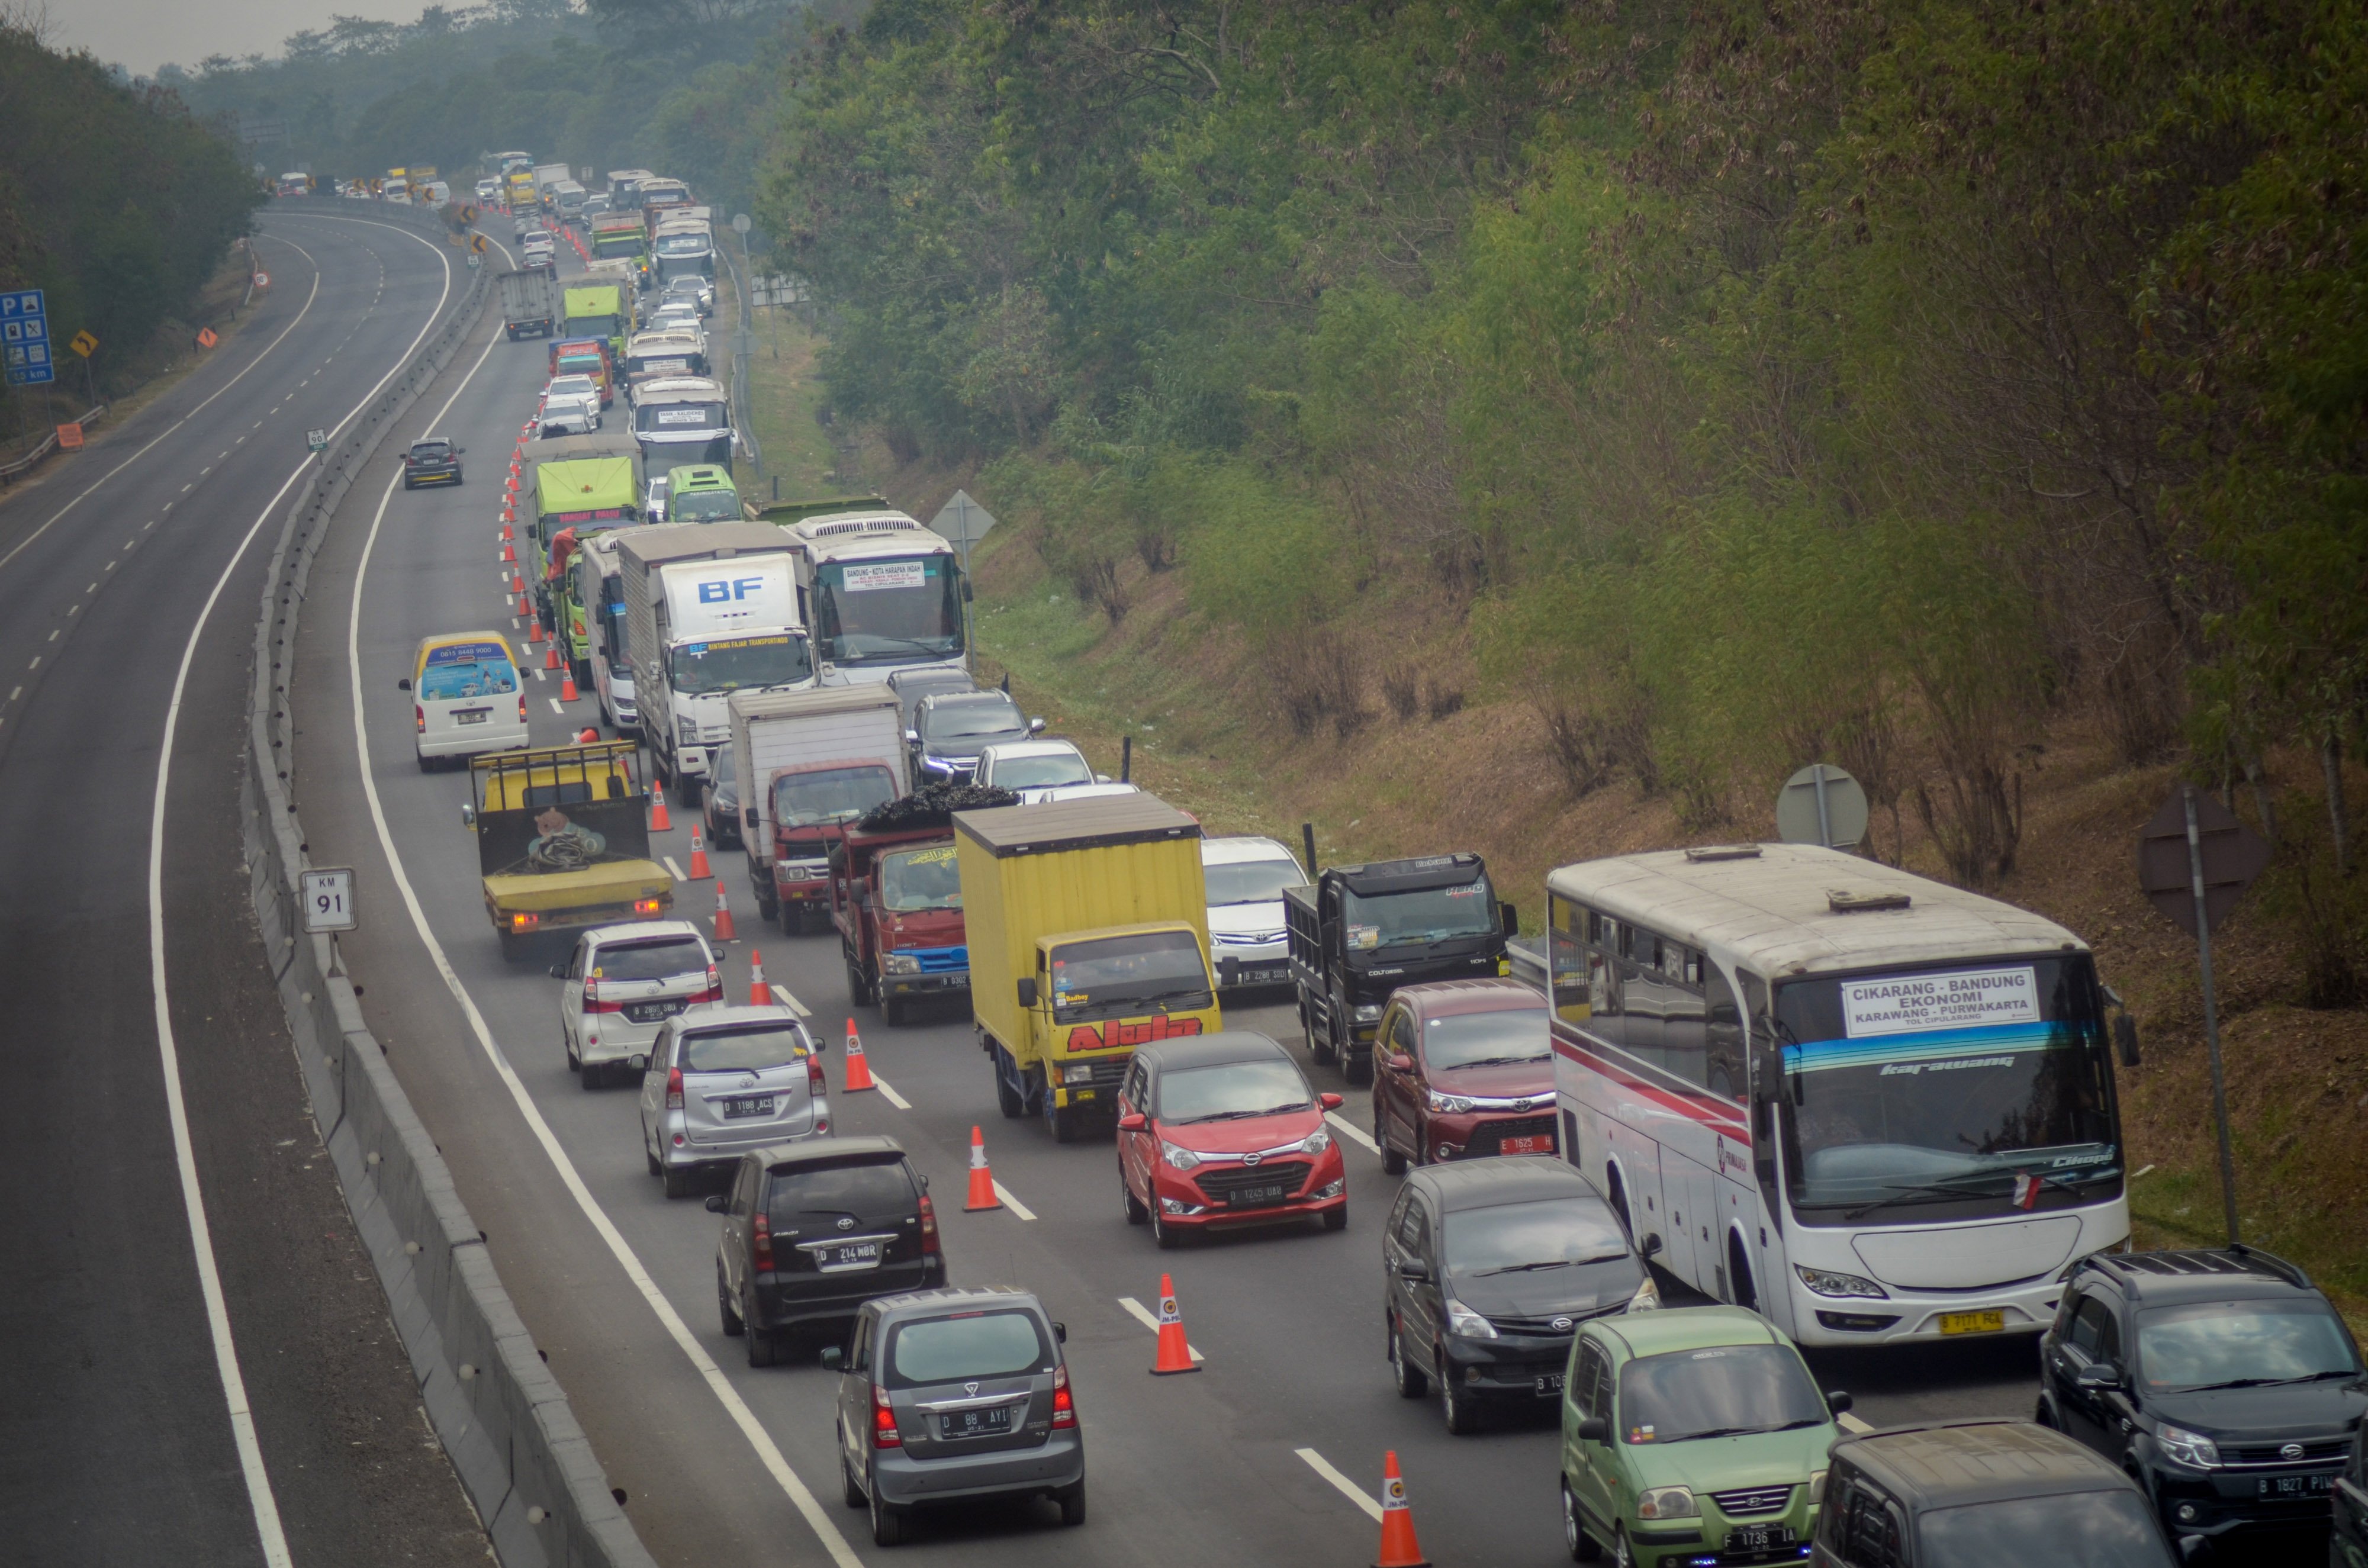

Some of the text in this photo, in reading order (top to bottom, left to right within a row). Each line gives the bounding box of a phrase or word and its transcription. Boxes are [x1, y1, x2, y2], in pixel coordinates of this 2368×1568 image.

[2, 297, 16, 315] P
[30, 369, 46, 378] km
[847, 569, 868, 577] BANDUNG
[699, 577, 763, 603] BF
[689, 643, 707, 652] BF
[749, 637, 789, 646] TRANSPORTINDO
[319, 877, 335, 887] KM
[317, 894, 341, 914] 91
[1853, 983, 1935, 1000] CIKARANG
[1949, 975, 2025, 991] BANDUNG
[1899, 991, 1982, 1008] EKONOMI
[1855, 1008, 1929, 1023] KARAWANG
[1941, 1000, 2028, 1015] PURWAKARTA
[1925, 1013, 1981, 1023] CIPULARANG
[1880, 1057, 2015, 1076] karawang
[725, 1099, 772, 1111] D 1188 ACS
[1502, 1136, 1550, 1150] E 1625 H
[1231, 1191, 1236, 1200] D
[820, 1251, 826, 1261] D
[841, 1247, 856, 1259] 214
[1942, 1316, 1948, 1328] B
[1537, 1378, 1544, 1389] B
[943, 1410, 1006, 1428] D 88 AYI
[2261, 1480, 2267, 1492] B
[2276, 1478, 2302, 1492] 1827
[1724, 1529, 1794, 1547] F 1736 IA
